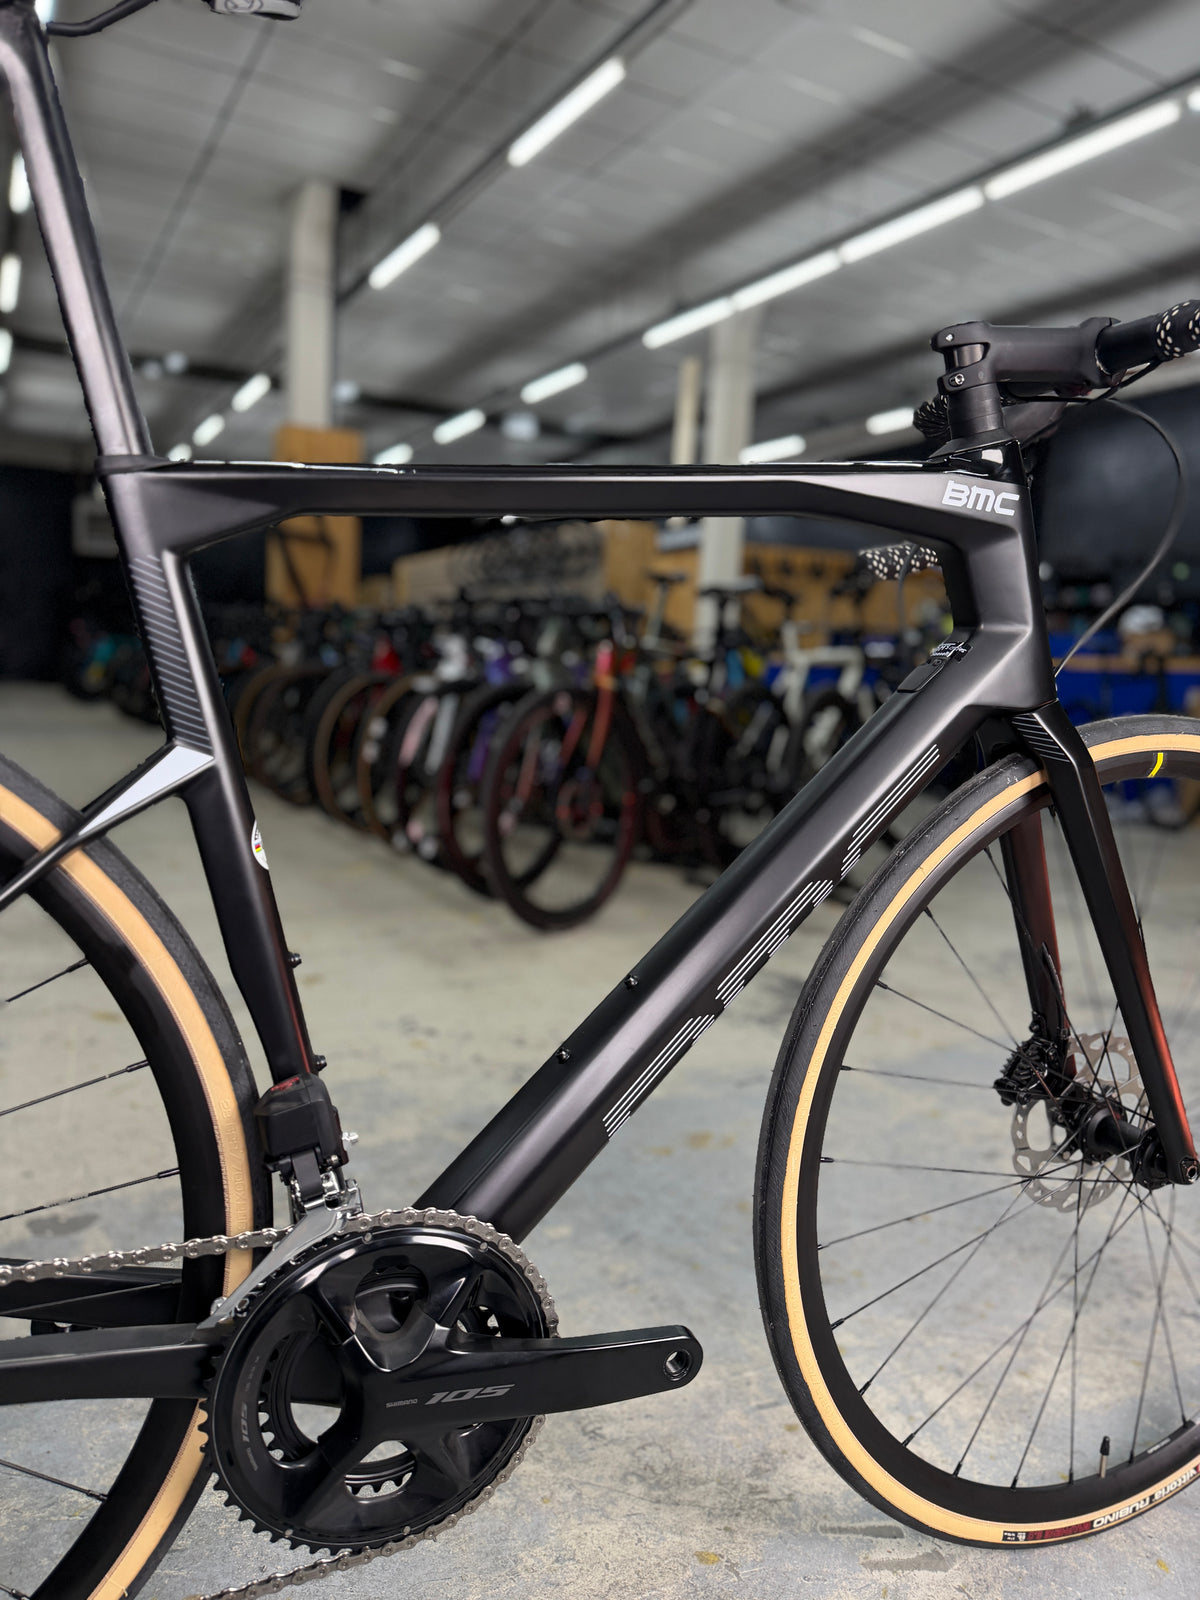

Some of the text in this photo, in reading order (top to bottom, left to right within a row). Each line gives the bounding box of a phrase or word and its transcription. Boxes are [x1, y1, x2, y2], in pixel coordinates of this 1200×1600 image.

[941, 479, 1020, 517] BMC
[386, 1384, 516, 1409] SHIMANO 105
[1093, 1496, 1151, 1528] RUBINO
